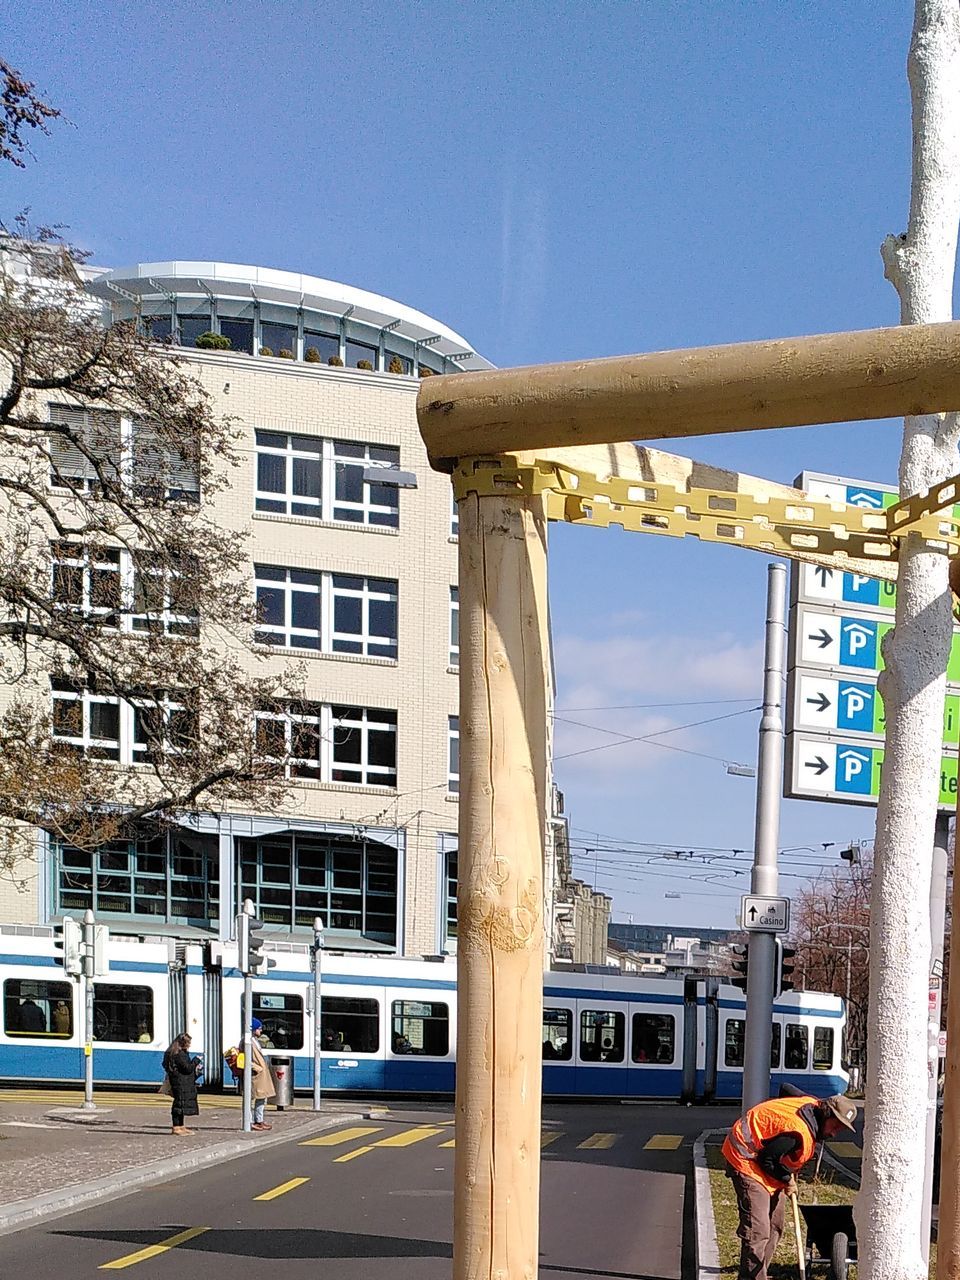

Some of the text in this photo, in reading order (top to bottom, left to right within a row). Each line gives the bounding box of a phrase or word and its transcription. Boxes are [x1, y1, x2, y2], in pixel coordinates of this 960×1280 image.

[849, 634, 867, 656] P
[847, 697, 865, 719] P
[845, 760, 863, 782] P
[759, 915, 784, 926] Casino
